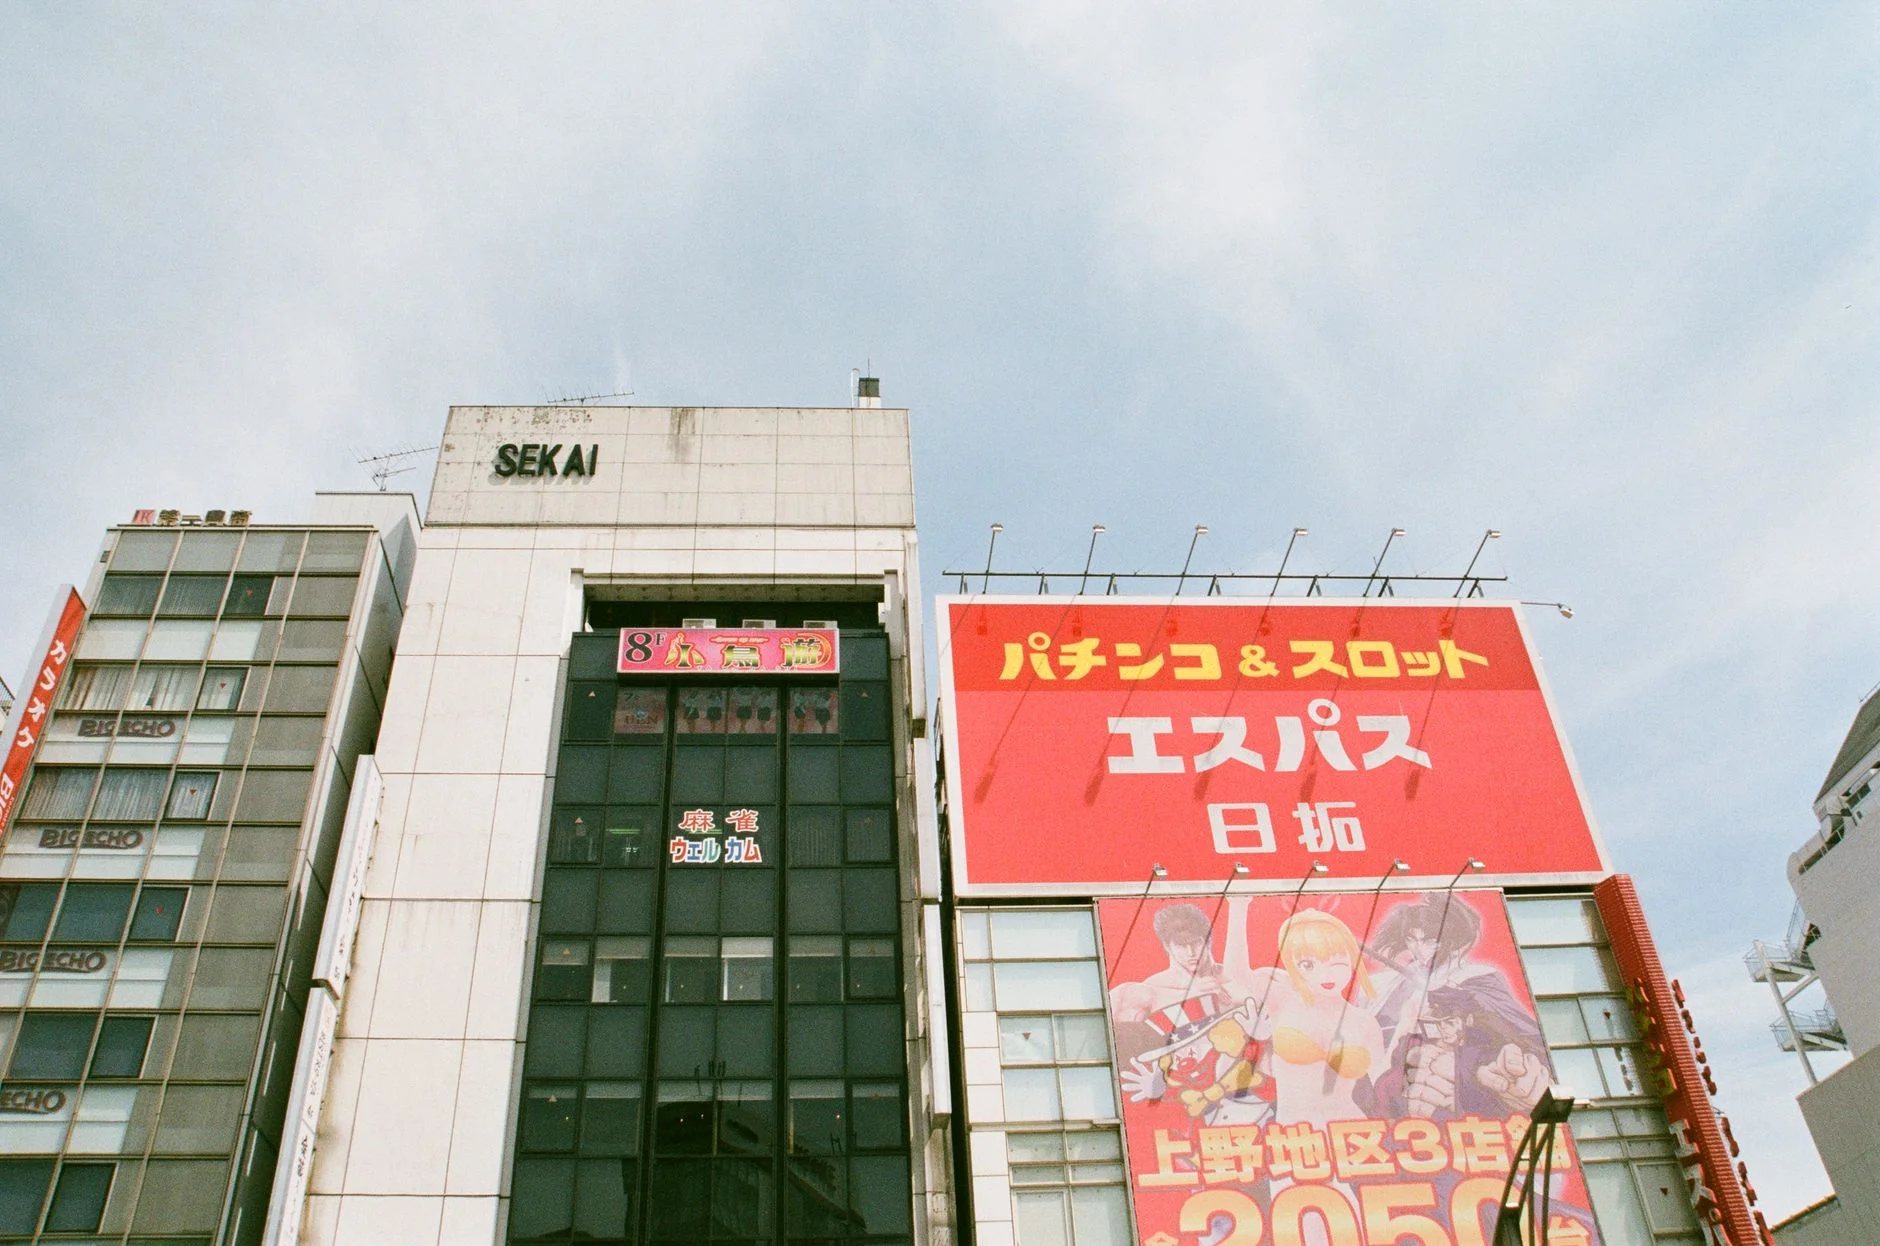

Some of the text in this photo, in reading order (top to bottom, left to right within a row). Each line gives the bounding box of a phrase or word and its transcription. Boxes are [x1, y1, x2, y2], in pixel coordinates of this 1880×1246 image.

[495, 443, 598, 477] SEKAI
[998, 632, 1489, 681] パチンコ & スロット
[17, 639, 67, 748] カラオケ
[1107, 698, 1434, 776] エスパス
[679, 809, 759, 832] 麻雀
[670, 837, 762, 864] ウェルカム
